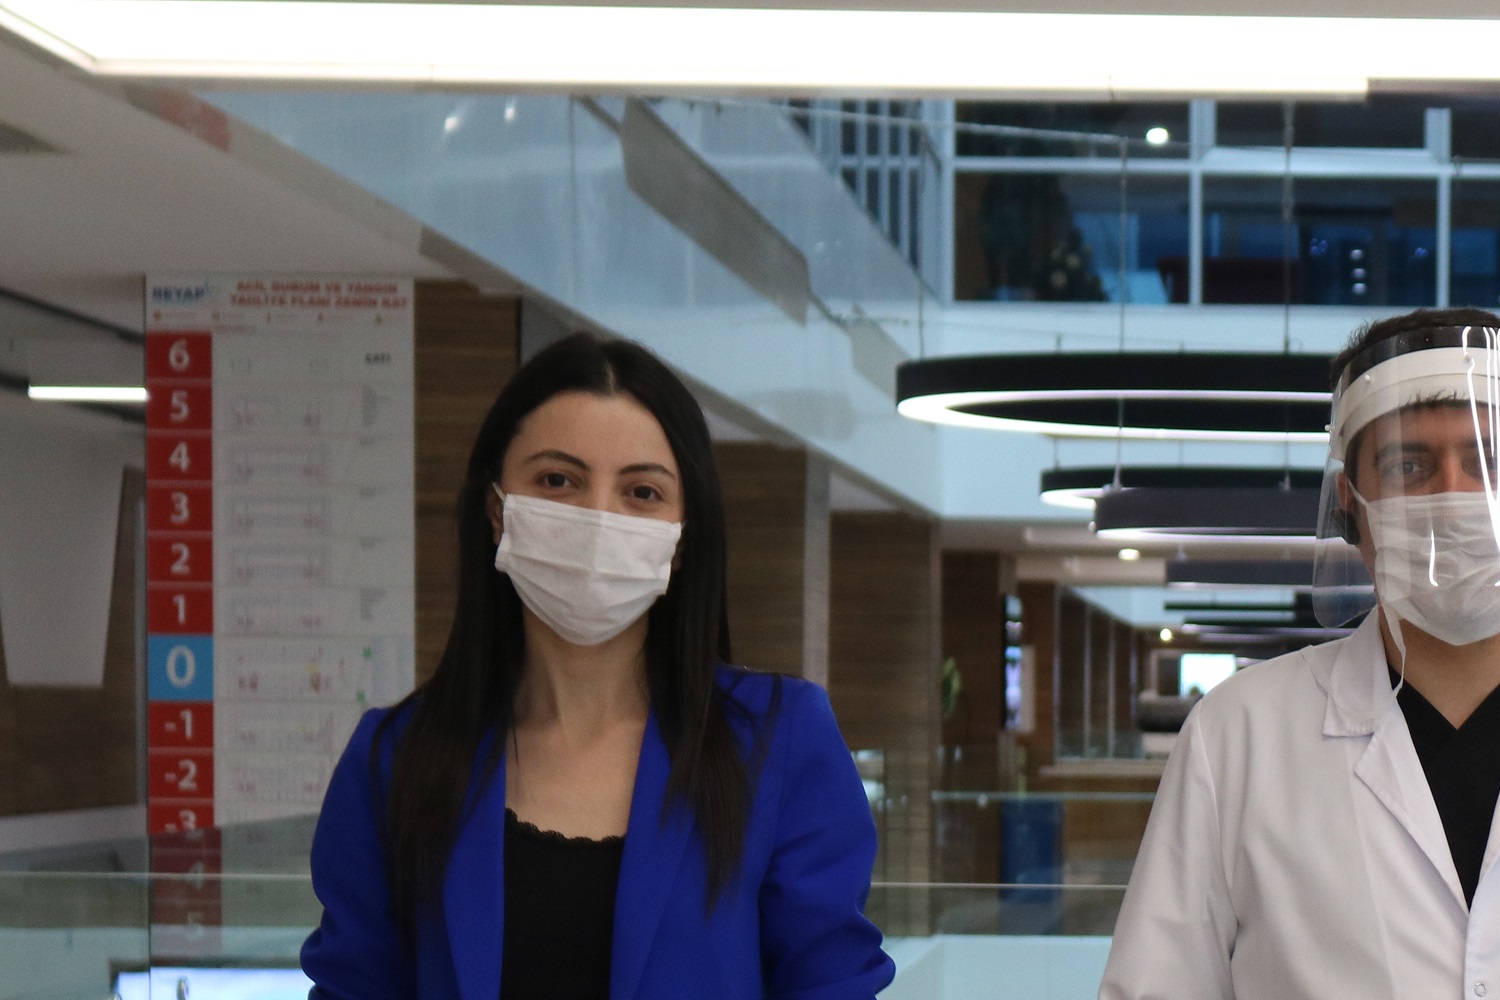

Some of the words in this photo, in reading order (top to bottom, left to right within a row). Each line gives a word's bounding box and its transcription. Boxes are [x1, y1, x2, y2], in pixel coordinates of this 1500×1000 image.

[169, 340, 190, 371] 6
[170, 391, 190, 422] 5
[169, 442, 190, 472] 4
[170, 492, 190, 523] 3
[170, 543, 190, 574] 2
[173, 594, 186, 625] 1
[166, 646, 196, 687] 0
[164, 709, 193, 739] -1
[164, 760, 197, 790] -2
